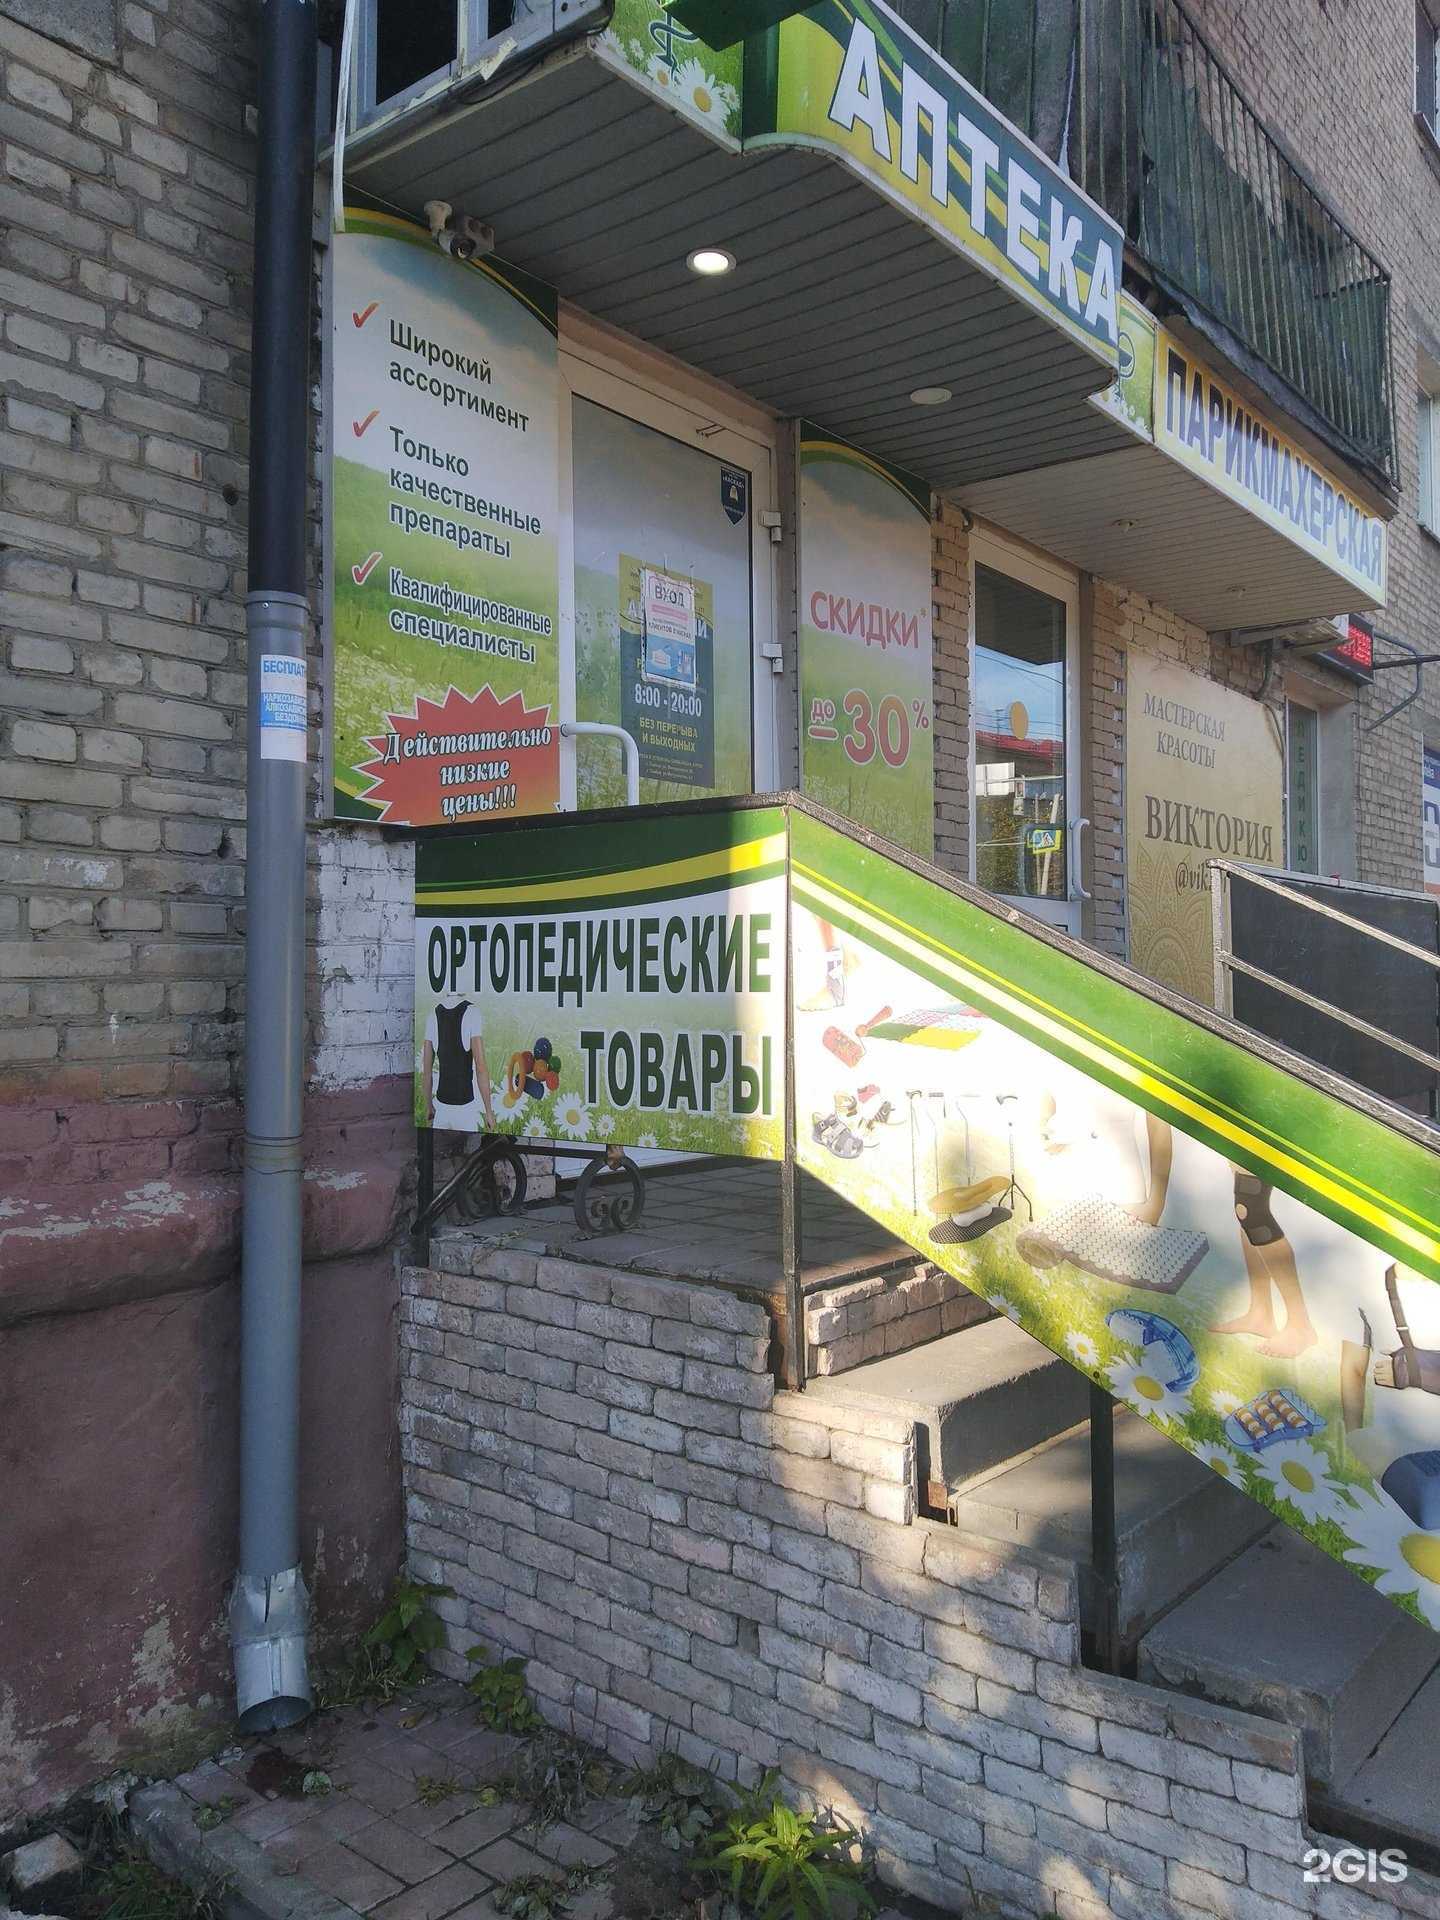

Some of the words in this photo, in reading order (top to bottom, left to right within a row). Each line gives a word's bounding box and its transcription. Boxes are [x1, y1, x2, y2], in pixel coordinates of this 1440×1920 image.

[828, 17, 1119, 345] АПТЕКА
[390, 319, 491, 384] Широкий
[389, 361, 529, 432] ассортимент
[389, 425, 469, 477] Только
[1166, 348, 1383, 586] ПАРИКМАХЕРСКАЯ
[390, 468, 541, 535] качественные
[390, 503, 510, 558] препараты
[391, 568, 551, 634] Квалифицированные
[655, 584, 685, 608] ВХОД
[390, 611, 536, 662] специалисты
[634, 683, 660, 708] 8:00
[671, 692, 702, 717] 20:00
[1143, 692, 1226, 742] МАСТЕРСКАЯ
[384, 726, 552, 765] Действительно
[639, 716, 655, 729] БЕЗ
[656, 719, 698, 739] ПЕРЕРЫВА
[642, 733, 649, 745] И
[650, 733, 696, 753] ВЫХОДНЫХ
[1156, 730, 1216, 769] КРАСОТЫ
[440, 758, 511, 785] низкие
[442, 785, 517, 822] цены!!!
[1144, 794, 1274, 863] ВИКТОРИЯ
[427, 913, 772, 1008] ОРТОПЕДИЧЕСКИЕ
[580, 1030, 773, 1116] ТОВАРЫ
